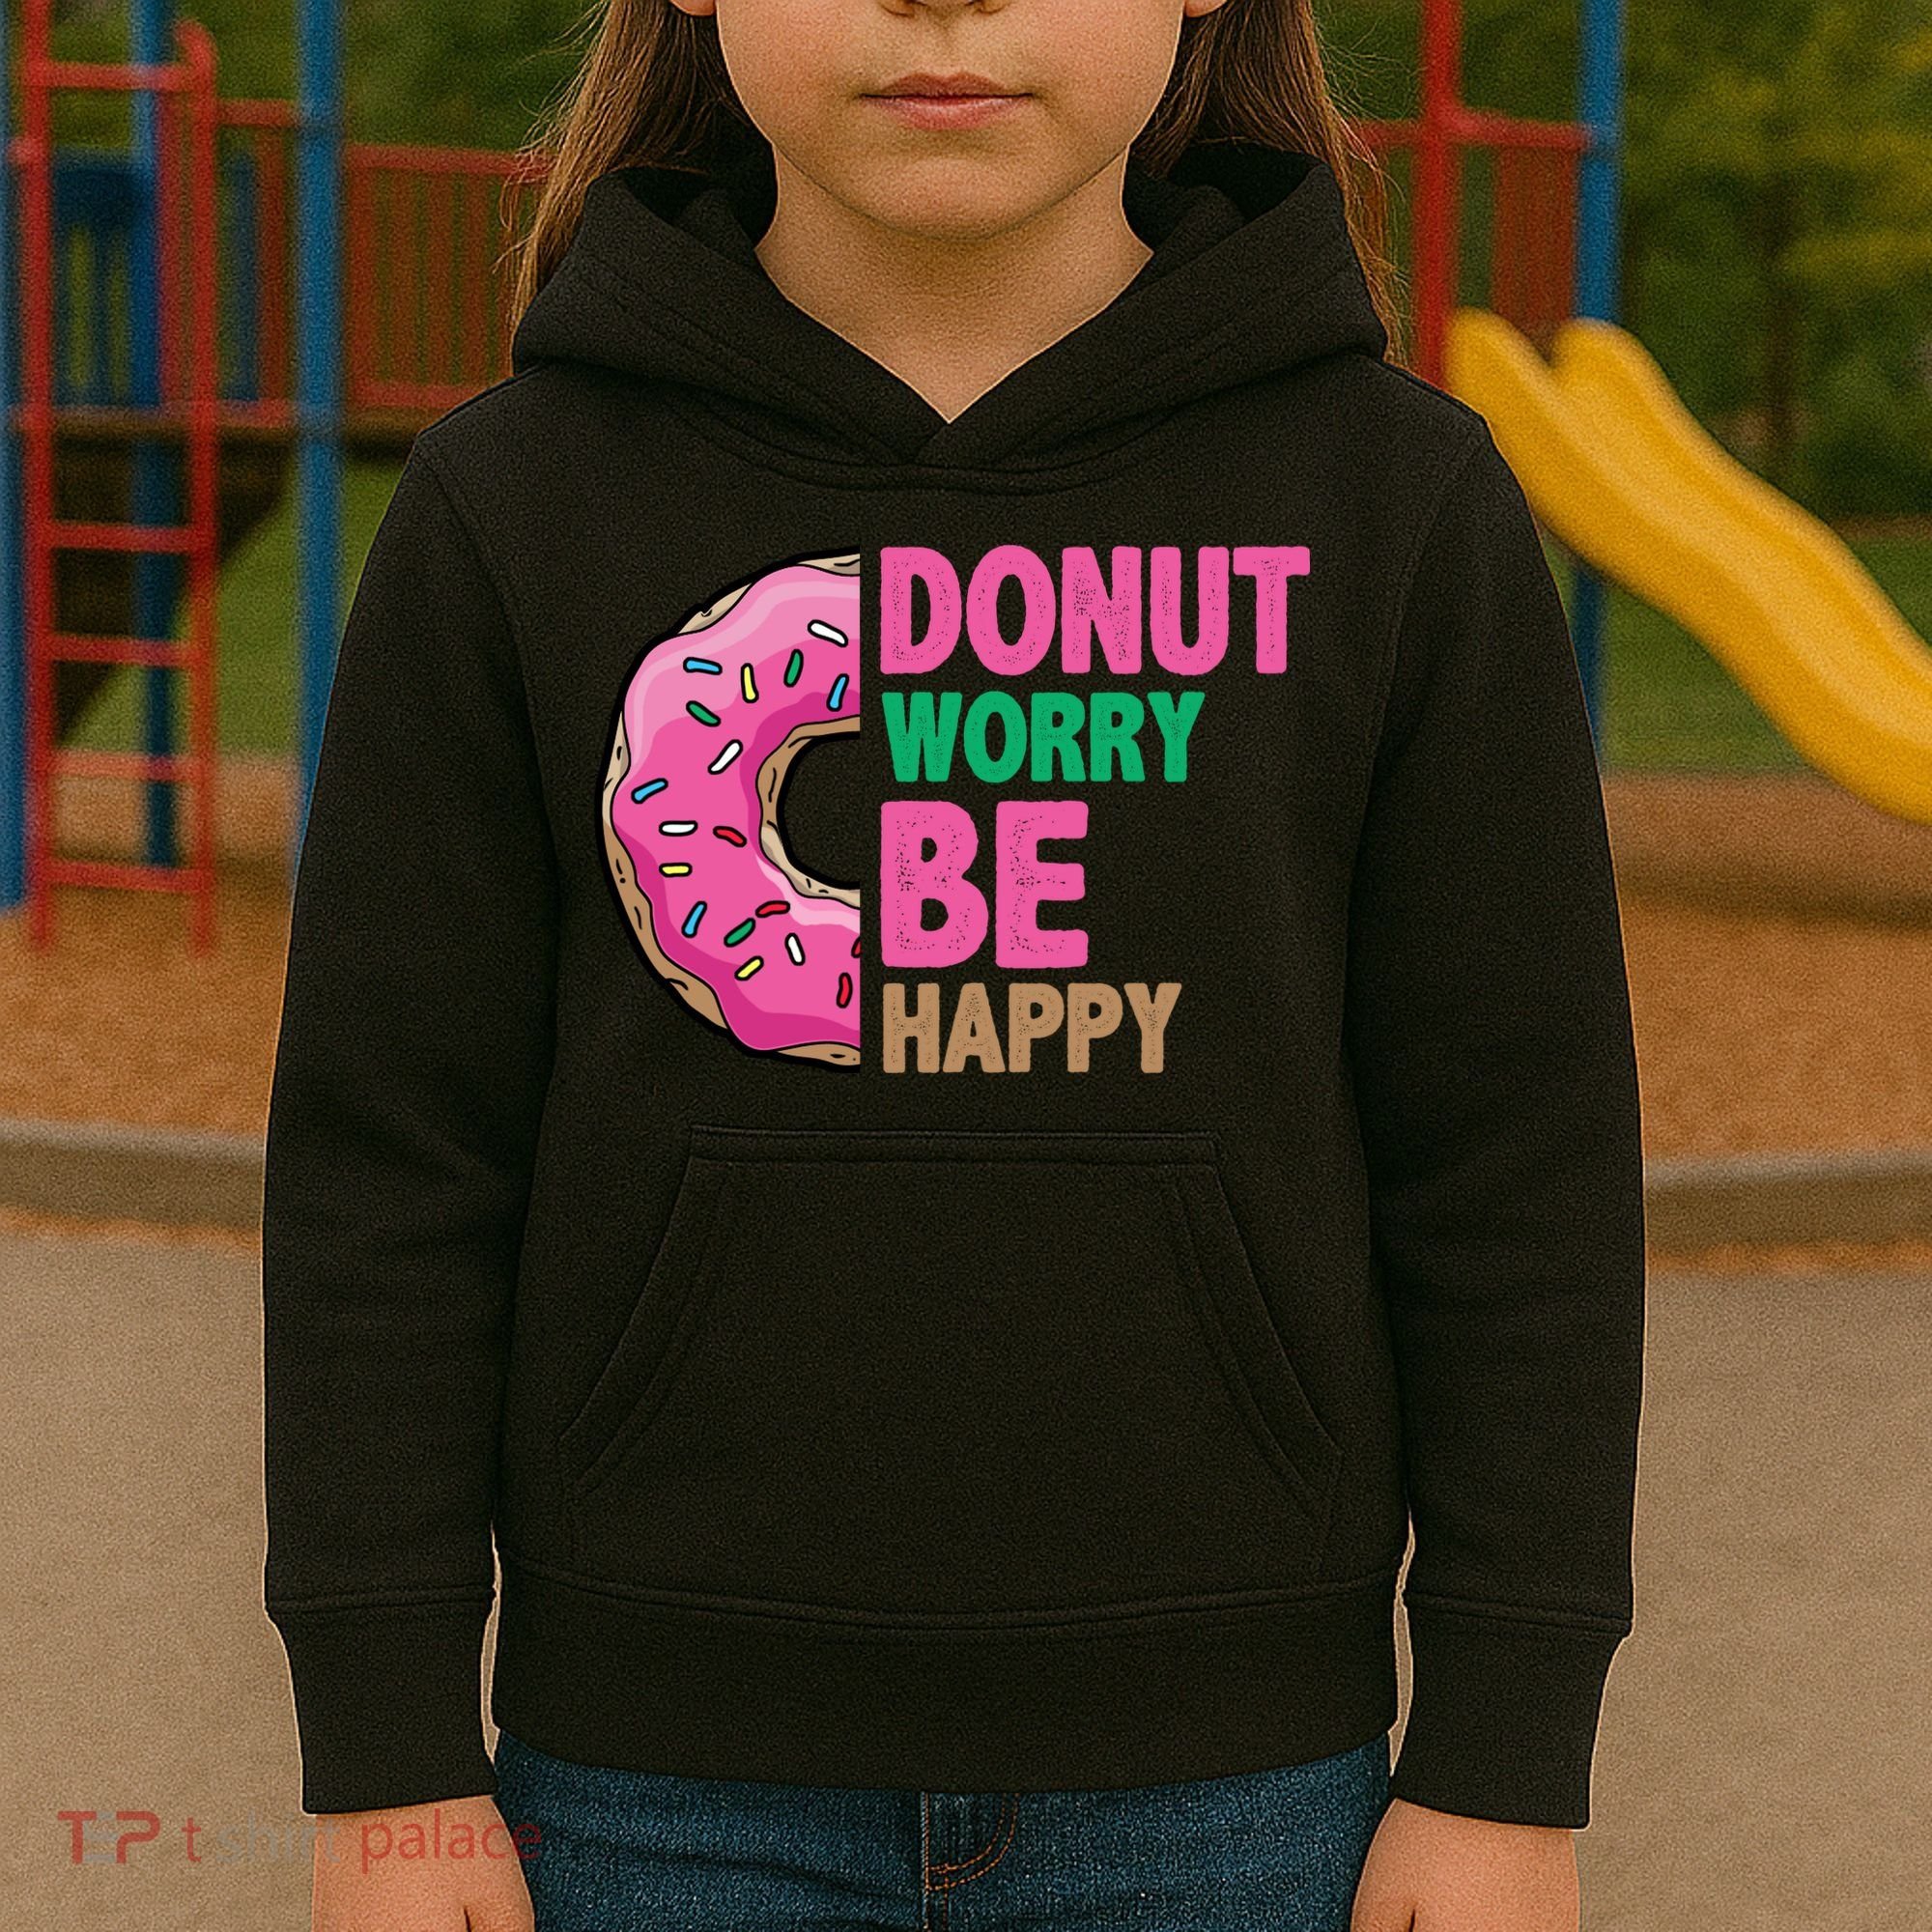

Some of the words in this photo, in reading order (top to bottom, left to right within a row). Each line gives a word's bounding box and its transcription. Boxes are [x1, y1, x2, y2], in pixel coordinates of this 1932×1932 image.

[879, 544, 1311, 676] DONUT
[880, 691, 1206, 783] WORRY
[879, 800, 1090, 969] BE
[882, 981, 1182, 1074] HAPPY
